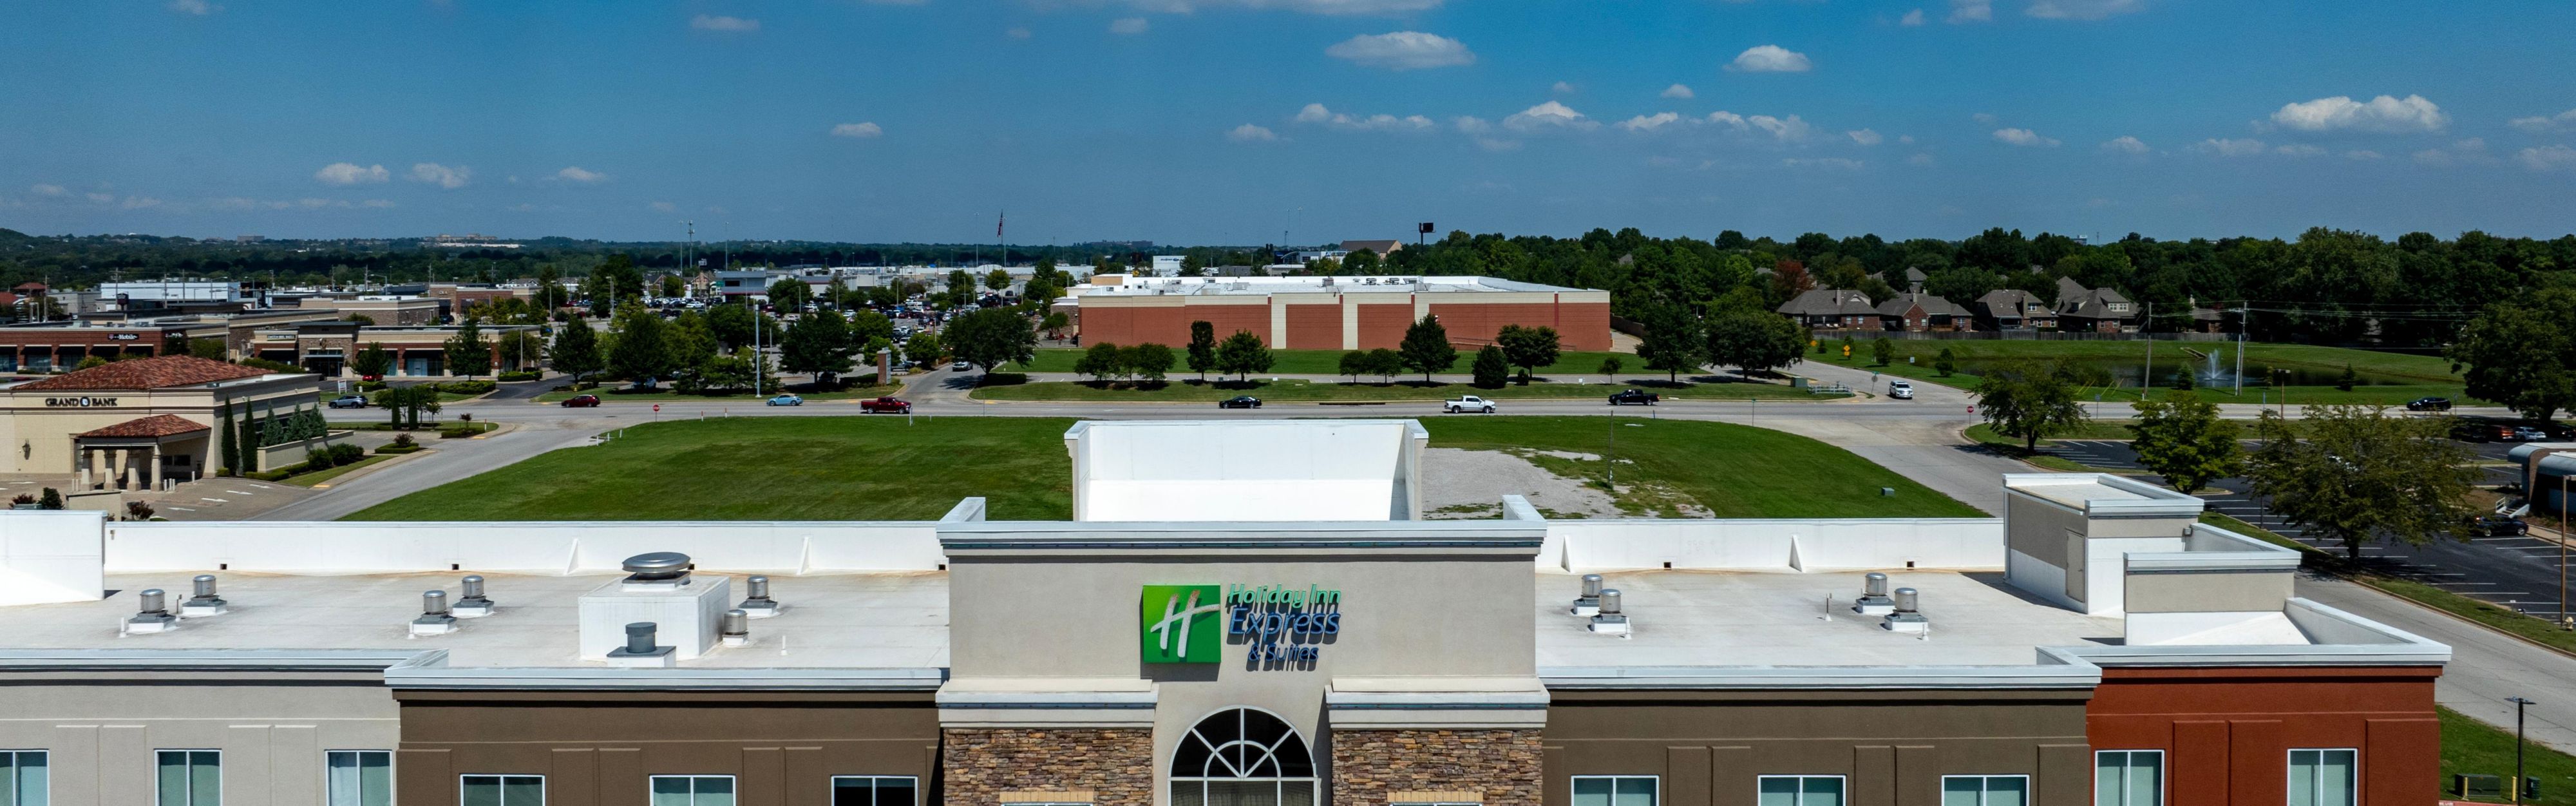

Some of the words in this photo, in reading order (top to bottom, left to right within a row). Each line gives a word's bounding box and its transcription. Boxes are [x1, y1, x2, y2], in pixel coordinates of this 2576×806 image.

[45, 398, 79, 407] GRAND
[91, 398, 118, 407] BANK
[1227, 583, 1307, 609] Holiday
[1309, 583, 1341, 604] Inn
[1229, 606, 1341, 642] Express
[1248, 644, 1261, 662] &
[1265, 644, 1320, 662] Suites
